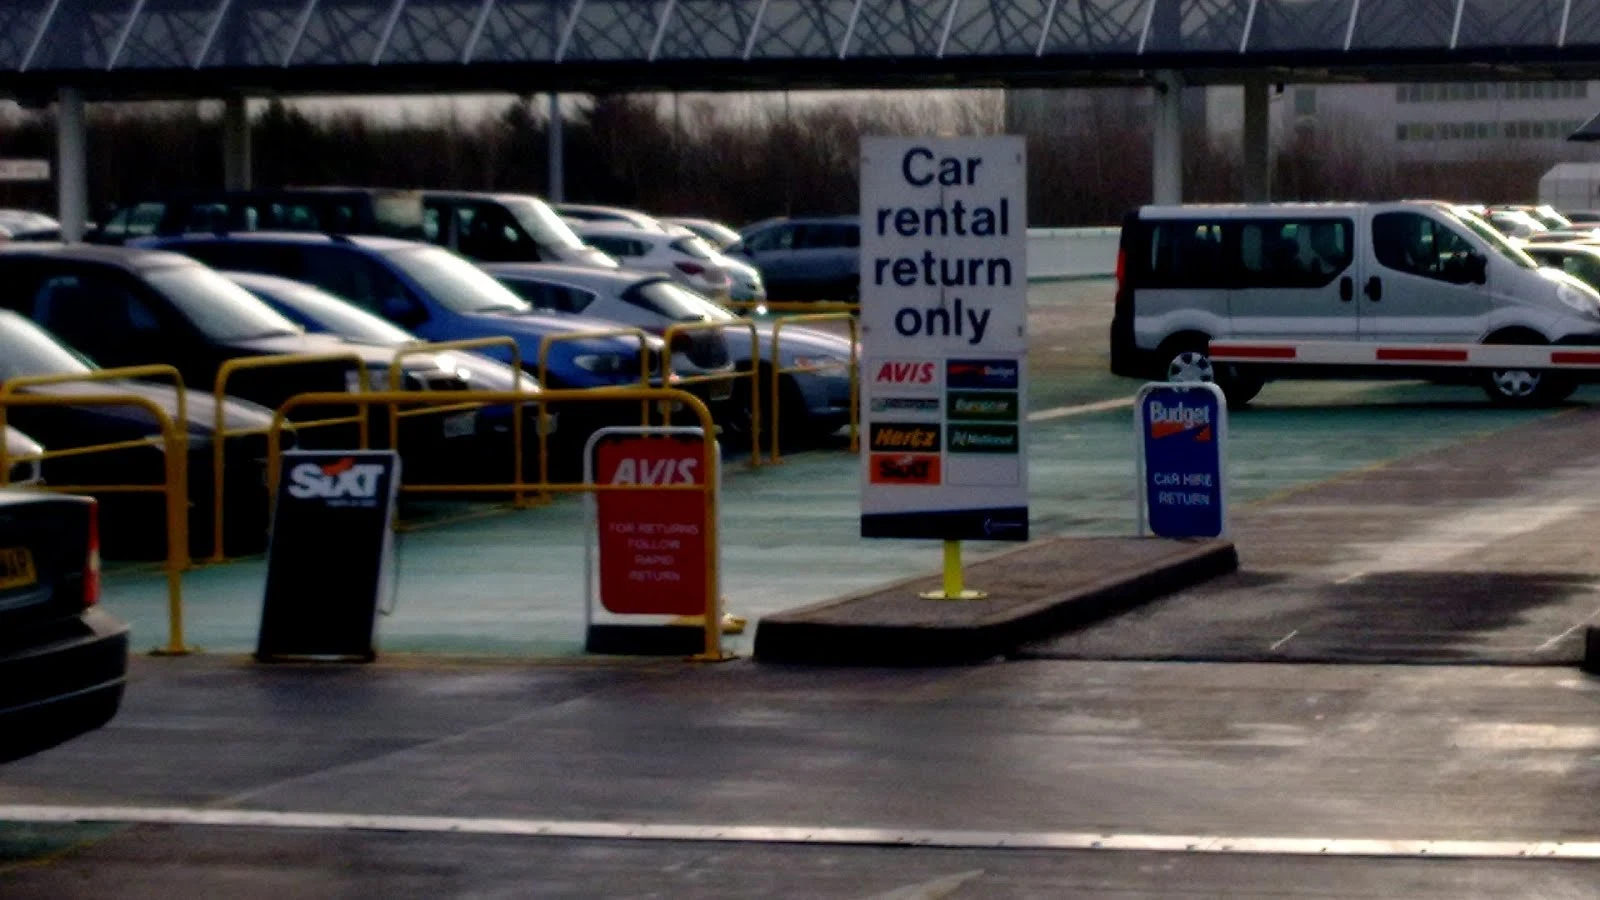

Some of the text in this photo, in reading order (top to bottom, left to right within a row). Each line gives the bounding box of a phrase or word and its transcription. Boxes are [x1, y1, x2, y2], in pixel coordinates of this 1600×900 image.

[902, 147, 982, 186] Car
[877, 198, 1008, 236] rental
[875, 251, 1011, 286] return
[895, 298, 991, 345] only
[876, 362, 935, 384] AVIS
[1150, 401, 1209, 429] Budget
[875, 427, 937, 447] Hertz
[610, 458, 698, 487] AVIS
